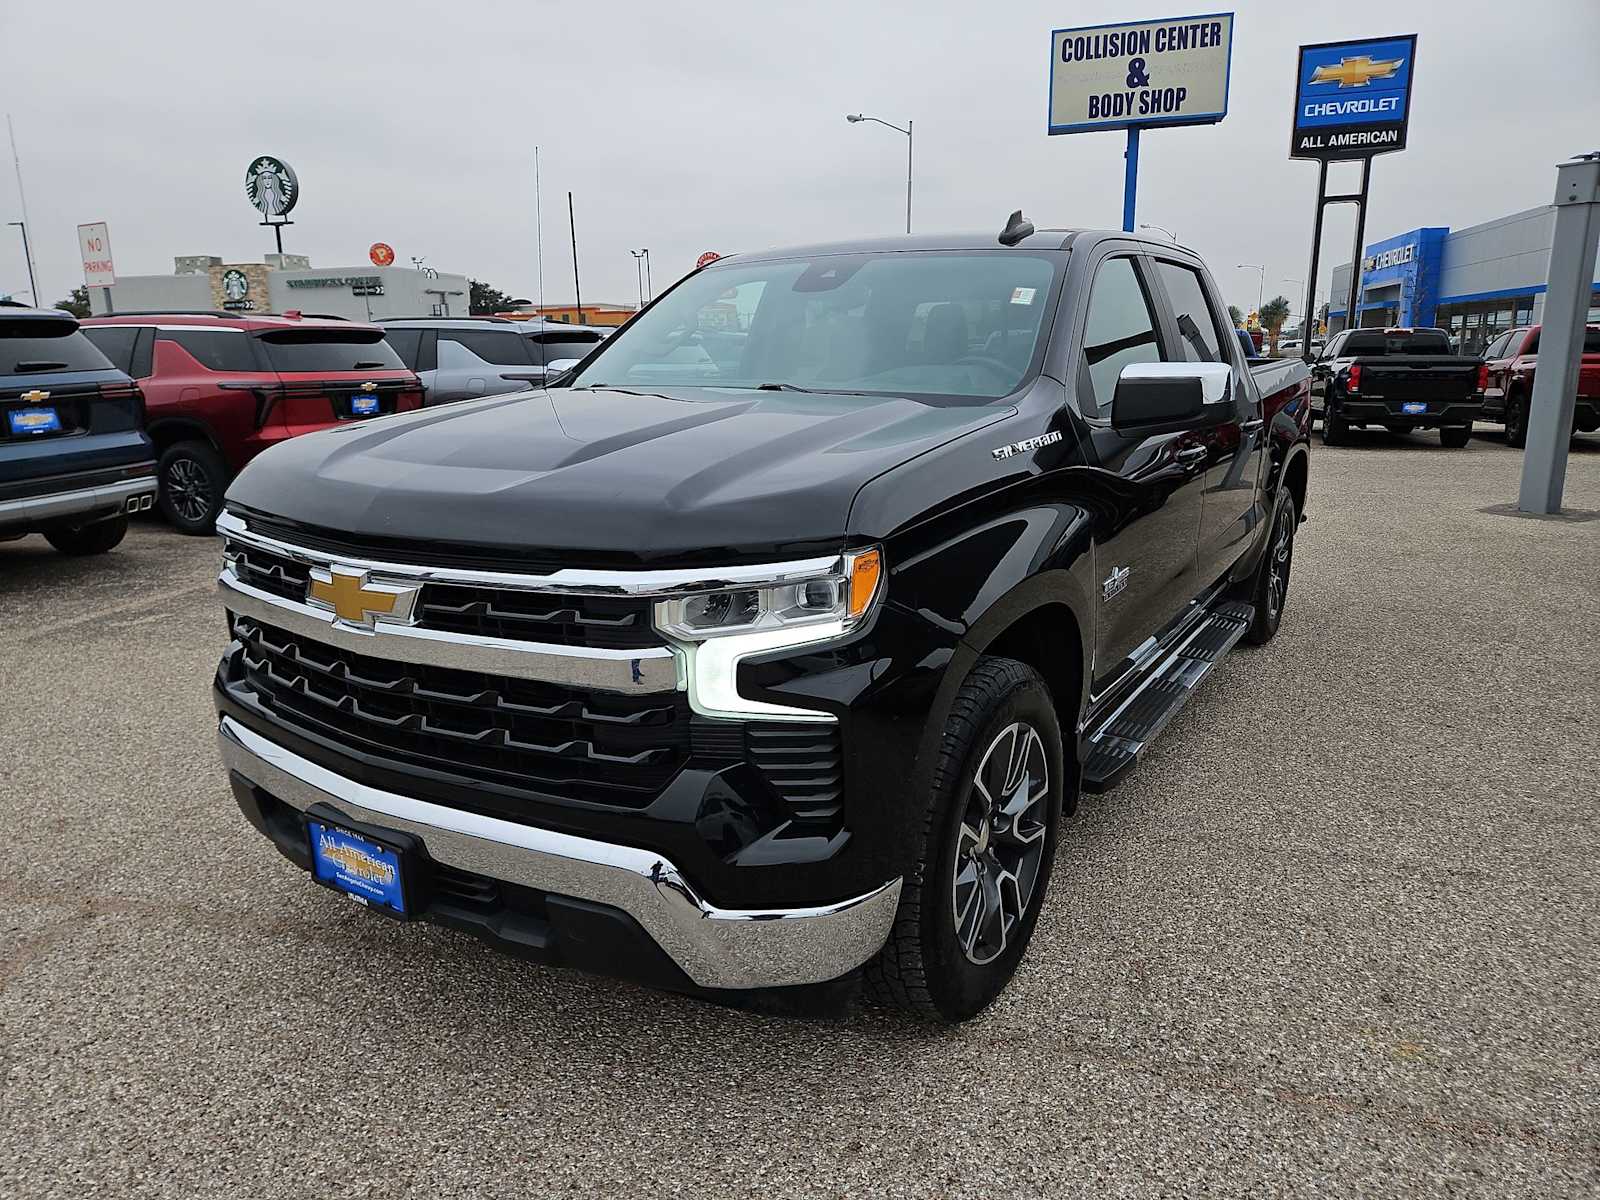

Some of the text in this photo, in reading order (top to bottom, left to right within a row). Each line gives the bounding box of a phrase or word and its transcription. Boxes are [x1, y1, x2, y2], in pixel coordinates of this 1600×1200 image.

[1061, 22, 1222, 63] COLLISION CENTER
[1126, 57, 1150, 89] &
[1088, 87, 1187, 119] BODY SHOP
[1304, 97, 1400, 117] CHEVROLET
[1300, 130, 1398, 149] ALL AMERICAN
[87, 238, 102, 252] NO
[1376, 243, 1415, 270] CHEVROLET
[84, 260, 112, 272] PARKING
[992, 430, 1063, 461] SILVERADO
[319, 834, 396, 875] All American
